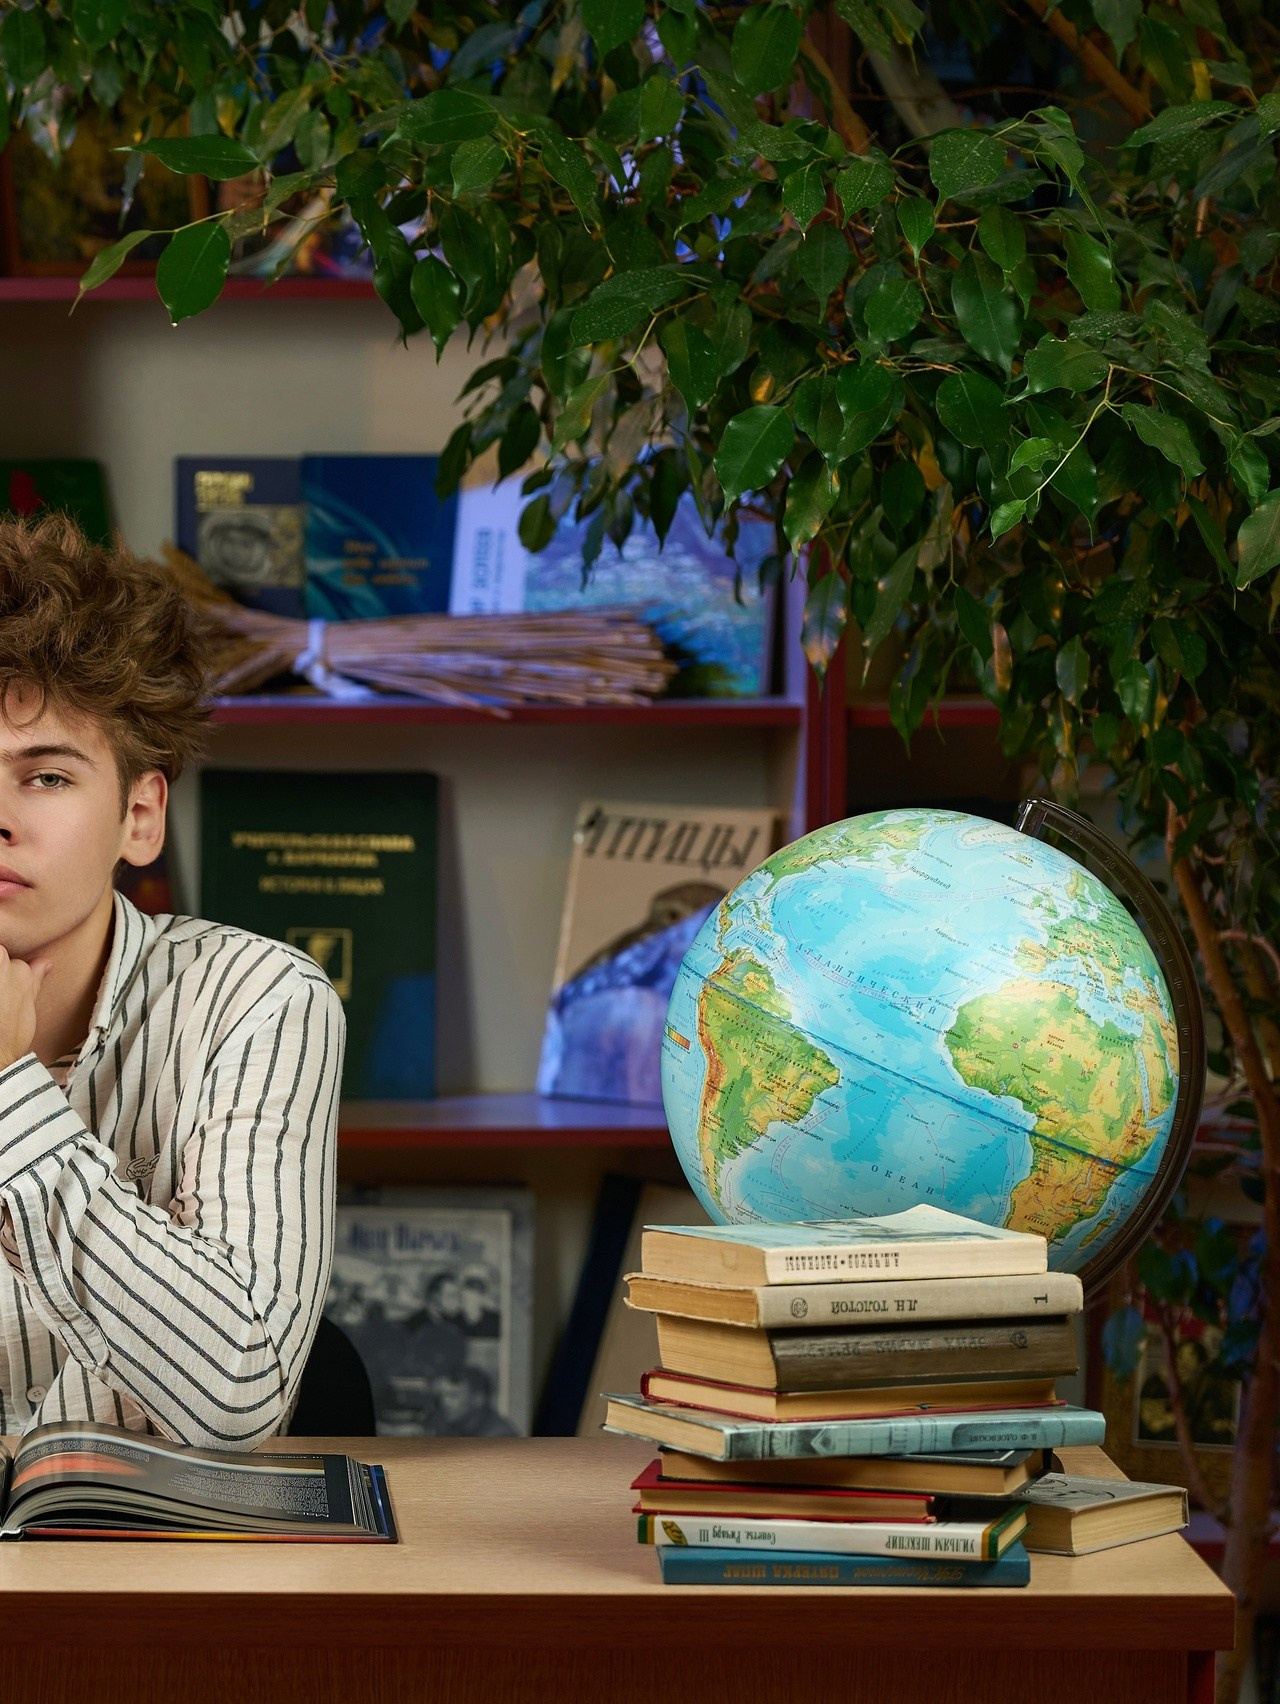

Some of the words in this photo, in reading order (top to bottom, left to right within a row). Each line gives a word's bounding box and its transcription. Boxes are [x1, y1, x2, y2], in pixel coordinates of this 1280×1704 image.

[910, 863, 951, 890] Ньюфаундленд
[795, 943, 937, 1015] АТЛАНТИЧЕСКИЙ
[871, 1164, 935, 1195] ОКЕАН
[831, 1299, 889, 1315] ТОЛСТОЙ
[875, 1338, 931, 1353] МАРИЯ
[969, 1432, 1018, 1443] ОДОЕВСКИЙ
[885, 1534, 931, 1550] ШЕКСПИР
[934, 1537, 976, 1553] УИЛЬЯМ
[722, 1565, 766, 1579] ШПАГ
[772, 1565, 839, 1579] ПЯТЕРКА
